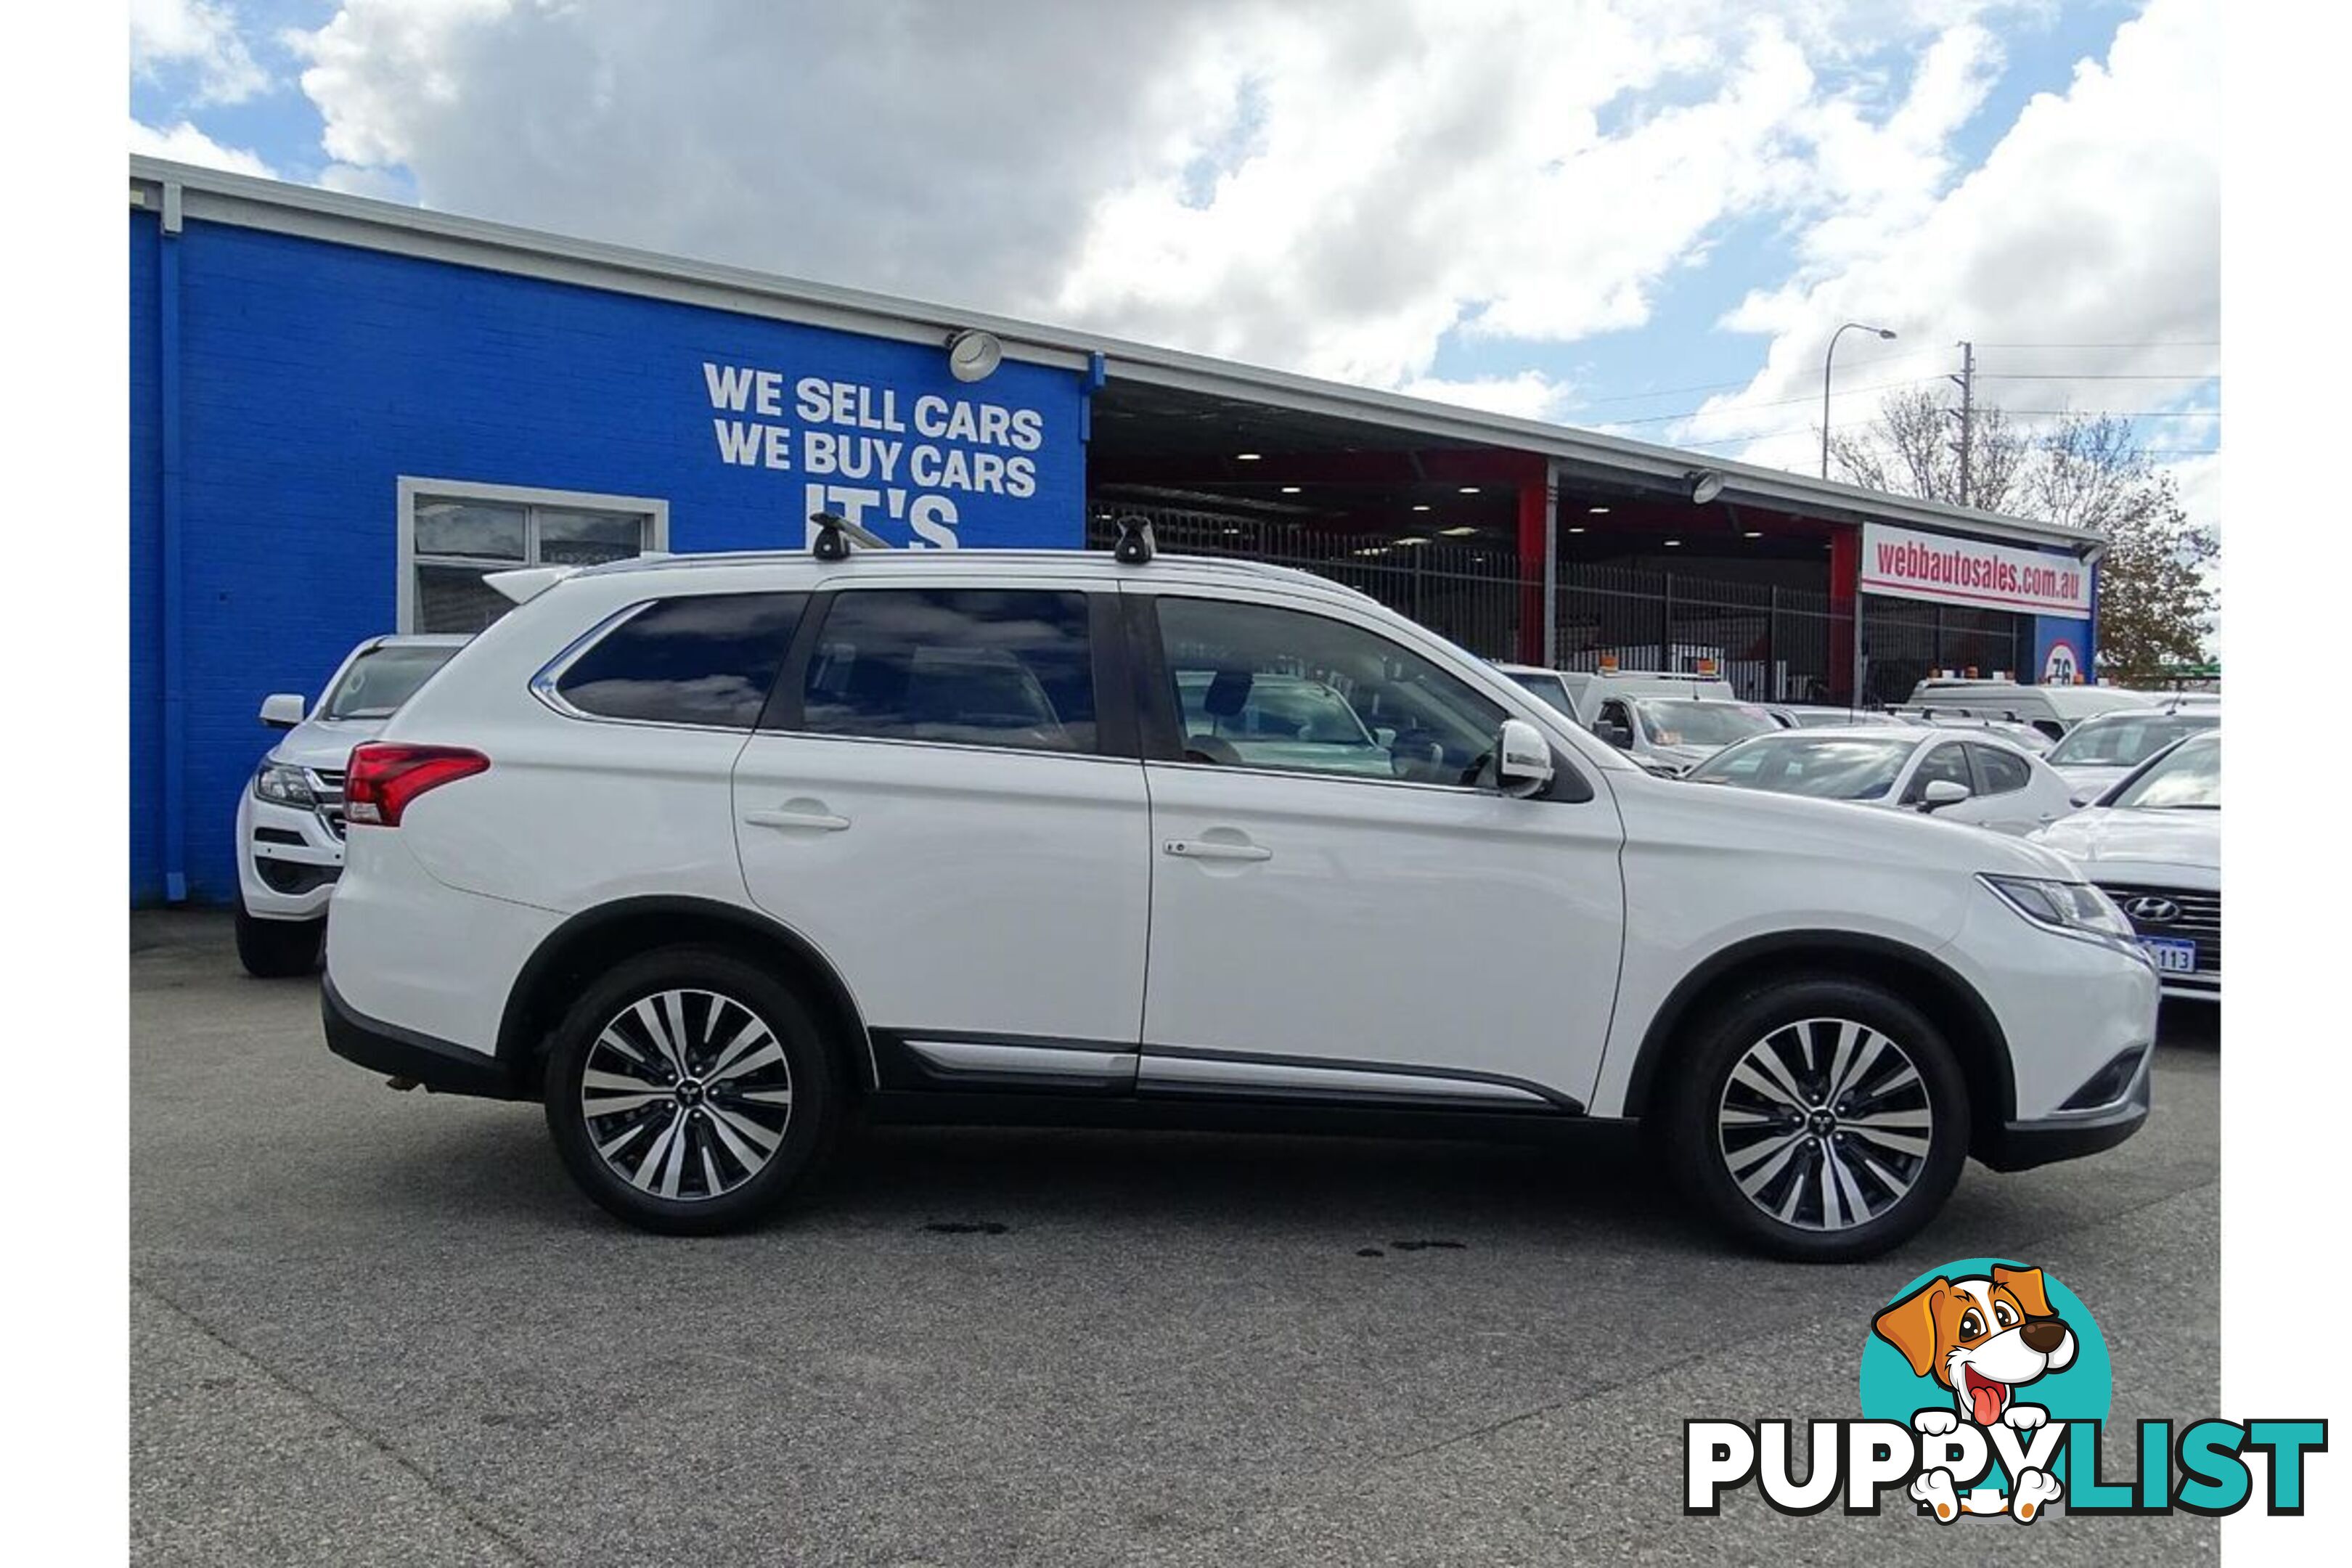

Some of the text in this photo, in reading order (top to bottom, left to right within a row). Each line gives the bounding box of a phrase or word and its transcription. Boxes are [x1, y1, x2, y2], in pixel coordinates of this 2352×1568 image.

[703, 362, 1043, 452] WE SELL CARS
[714, 419, 1036, 499] WE BUY CARS
[805, 483, 959, 550] IT'S
[1877, 540, 2081, 600] webbautosales.com.au
